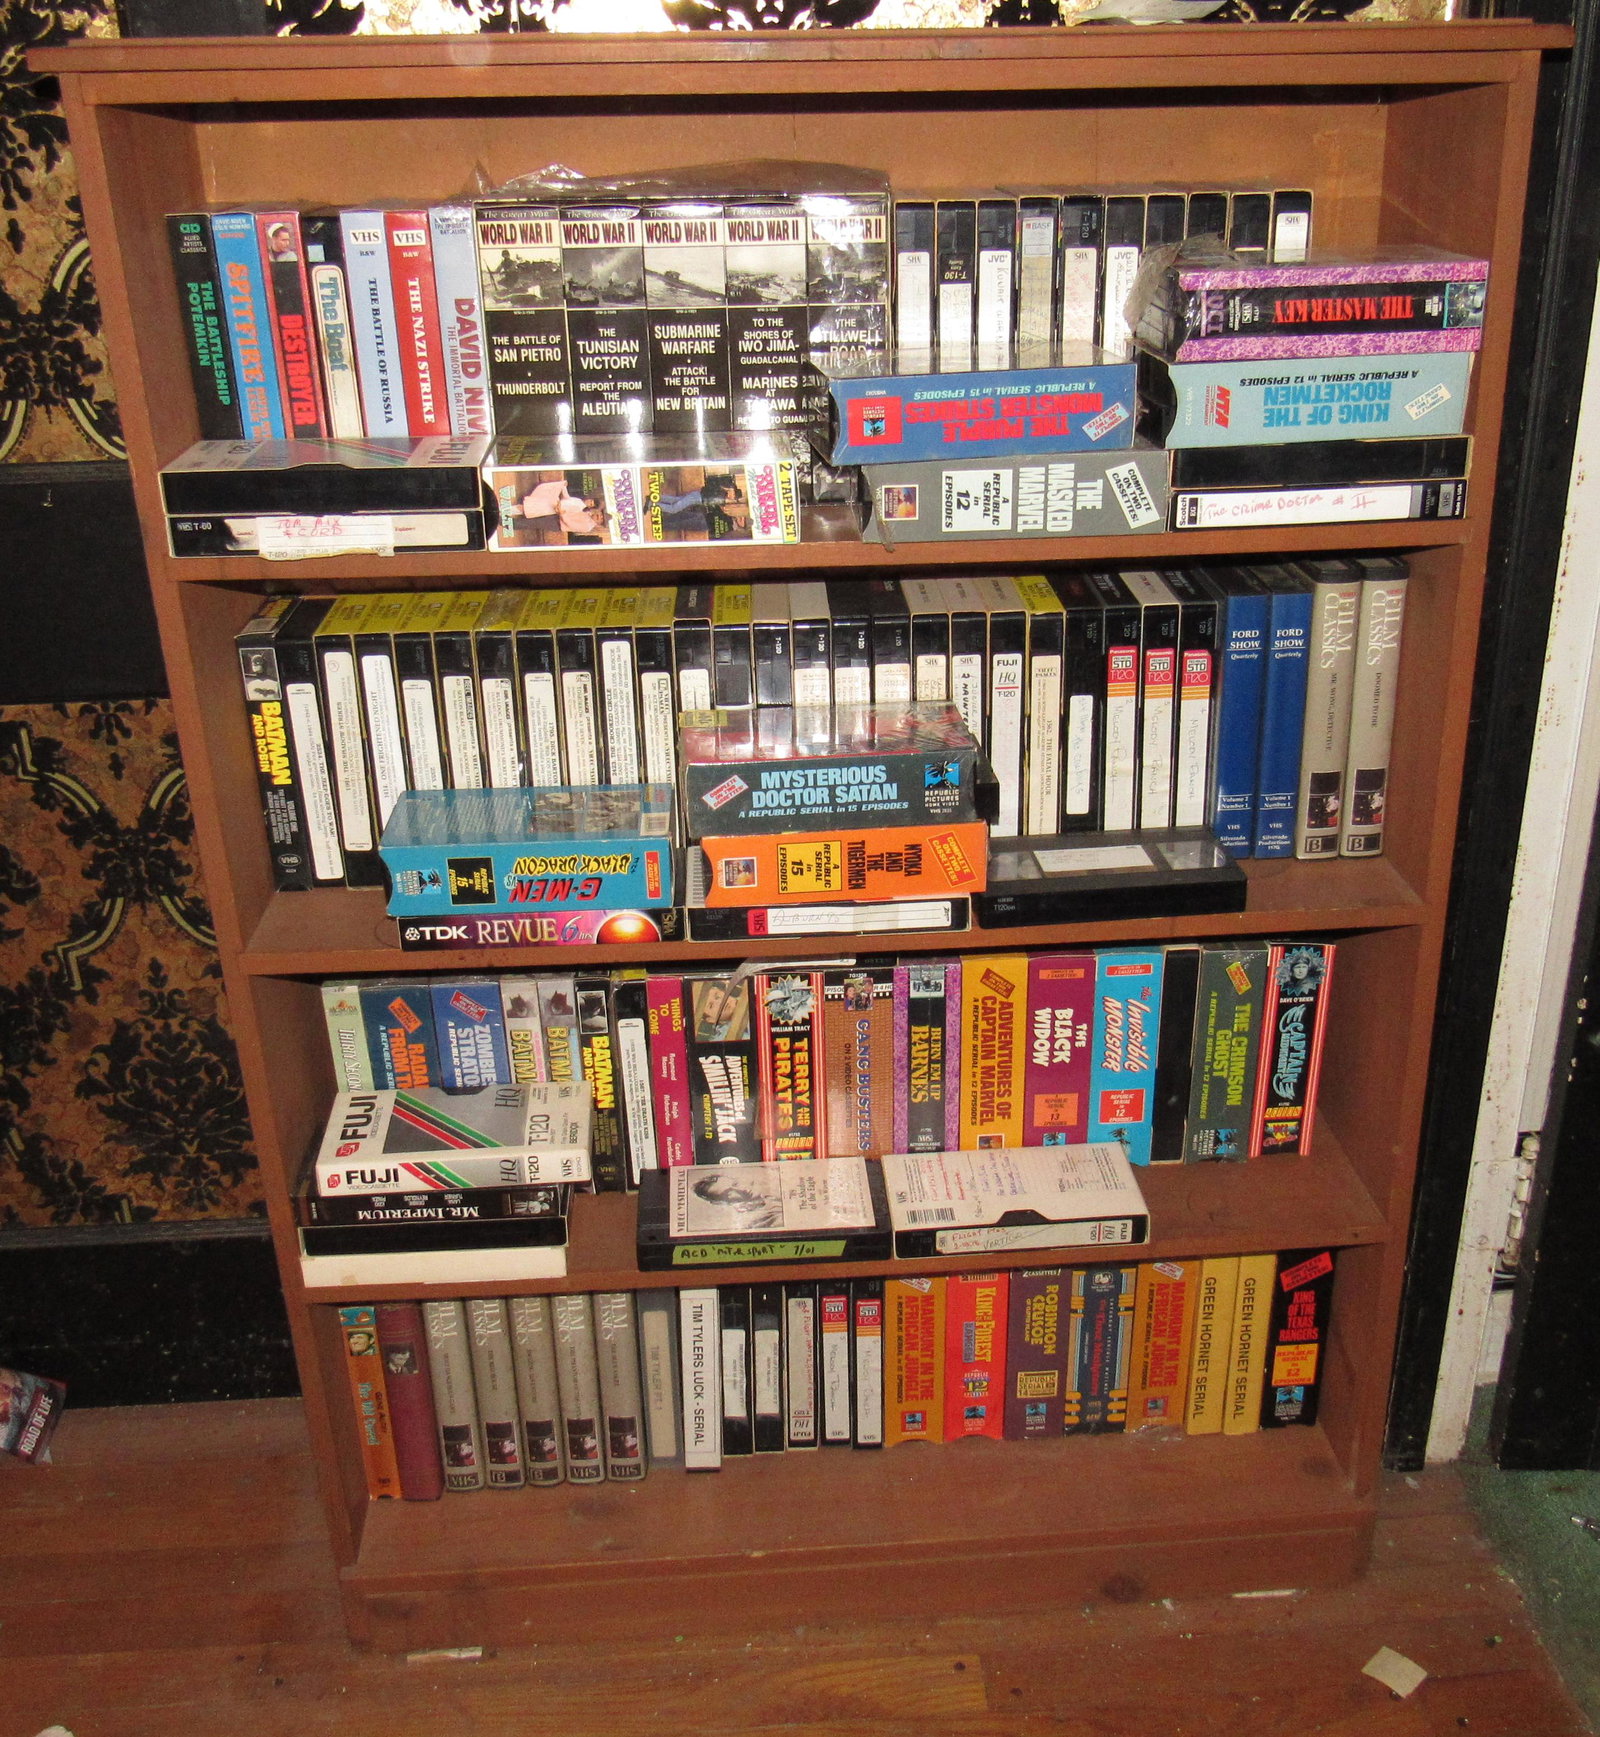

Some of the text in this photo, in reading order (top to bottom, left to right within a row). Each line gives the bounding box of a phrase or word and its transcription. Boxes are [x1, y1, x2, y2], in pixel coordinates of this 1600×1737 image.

[352, 232, 380, 243] VHS
[394, 232, 423, 244] VHS
[480, 223, 553, 244] WORLD WAR II
[563, 223, 635, 244] WORLD WAR II
[645, 220, 717, 243] WORLD WAR II
[728, 220, 799, 242] WORLD WAR II
[988, 254, 1005, 263] JVC
[186, 282, 211, 367] POTEMKIN
[227, 262, 263, 384] SPITFIRE
[320, 276, 347, 373] The Boat
[655, 324, 721, 339] SUBMARINE
[753, 318, 784, 327] TO THE
[200, 282, 231, 406] THE BATTLESHIP
[492, 336, 561, 345] THE BATTLE OF
[739, 341, 800, 352] IWO JIMA-
[743, 330, 793, 340] SHORES OF
[368, 278, 393, 424] THE BATTLE OF RUSSIA
[407, 278, 435, 424] THE NAZI STRIKE
[495, 348, 561, 362] SAN PIETRO
[577, 340, 639, 354] TUNISIAN
[662, 340, 715, 355] WARFARE
[279, 314, 318, 426] DESTROYER
[454, 298, 490, 436] DAVID NIV
[580, 356, 638, 370] VICTORY
[672, 367, 707, 375] ATTACK!
[741, 356, 798, 365] GUADALCANAL
[664, 377, 716, 386] THE BATTLE
[743, 377, 798, 389] MARINES
[1240, 377, 1290, 386] EPISODES
[1294, 375, 1304, 383] 12
[1320, 373, 1358, 382] SERIAL
[1360, 370, 1409, 381] REPUBLIC
[1411, 370, 1419, 378] A
[496, 382, 565, 395] THUNDERBOLT
[580, 382, 642, 392] REPORT FROM
[682, 388, 699, 396] FOR
[766, 389, 776, 397] AT
[1264, 382, 1392, 405] ROCKETMEN
[657, 397, 726, 410] NEW BRTAIN
[745, 399, 796, 411] TAAWA
[906, 393, 1104, 424] MONSTER STRIKES
[779, 463, 798, 538] 2 TAPE SET
[944, 476, 953, 528] EPISODES
[956, 490, 971, 511] 12
[983, 481, 991, 519] SERIAL
[992, 473, 1001, 526] REPUBLIC
[1017, 467, 1045, 532] MARVEL
[1047, 463, 1075, 532] MASKED
[1112, 472, 1139, 522] CASSETTES!
[1127, 468, 1153, 513] COMPLETE
[499, 486, 515, 538] WALTZ
[648, 472, 664, 542] TWO-STEP
[1179, 497, 1187, 526] Scotch
[1232, 630, 1259, 638] FORD
[1276, 628, 1304, 638] FORD
[1320, 593, 1339, 669] CLASSICS
[1230, 640, 1260, 649] SHOW
[1274, 639, 1304, 648] SHOW
[1274, 651, 1302, 659] Quarterly
[1112, 659, 1132, 669] STD
[1150, 661, 1170, 670] STD
[1230, 653, 1258, 661] Quarterly
[998, 671, 1016, 684] HQ
[260, 701, 292, 786] BATMAN
[761, 765, 887, 789] MYSTERIOUS
[752, 783, 898, 808] DOCTOR SATAN
[738, 801, 909, 818] A REPUBLIC SERIAL in 15 EPISODES
[514, 854, 632, 876] BLACK DRAGON
[847, 840, 867, 890] TIGERMEN
[885, 851, 902, 873] AND
[903, 843, 922, 877] NYOKA
[509, 877, 602, 902] G-MEN
[419, 926, 469, 940] TDK
[476, 918, 558, 944] REVUE
[561, 916, 582, 942] 6
[660, 1004, 668, 1016] TO
[670, 998, 681, 1032] THINGS
[650, 1009, 660, 1035] COME
[1033, 1008, 1052, 1067] WIDOW
[1052, 1008, 1074, 1064] BLACK
[1102, 996, 1123, 1072] MONSTER
[1124, 998, 1150, 1072] Invisible
[911, 1024, 930, 1103] BARNES
[980, 995, 997, 1126] CAPTAIN MARVEL
[1212, 1029, 1233, 1078] GHOST
[592, 1036, 615, 1109] BATMAN
[669, 1053, 677, 1081] Raymond
[793, 1038, 810, 1105] TERRY
[774, 1037, 794, 1133] PIRATES
[856, 1019, 872, 1151] GANG BUSTERS
[494, 1088, 522, 1109] HQ
[340, 1095, 378, 1140] FUJI
[346, 1168, 400, 1184] FUJI
[358, 1206, 480, 1220] MR. IMPERIUM
[826, 1304, 842, 1312] STD
[1044, 1284, 1059, 1355] ROBINSON
[975, 1287, 997, 1362] KING FOREST
[1031, 1295, 1045, 1345] CRUSOE
[1288, 1316, 1315, 1328] TEXAS
[1279, 1328, 1319, 1342] RANGERS
[1193, 1277, 1216, 1419] GREEN HORNET SERIAL
[1232, 1277, 1256, 1420] GREEN HORNET SERIAL
[692, 1304, 705, 1446] TIM TYLERS LUCK SERIAL
[21, 1394, 53, 1455] ROAD OF LIFE
